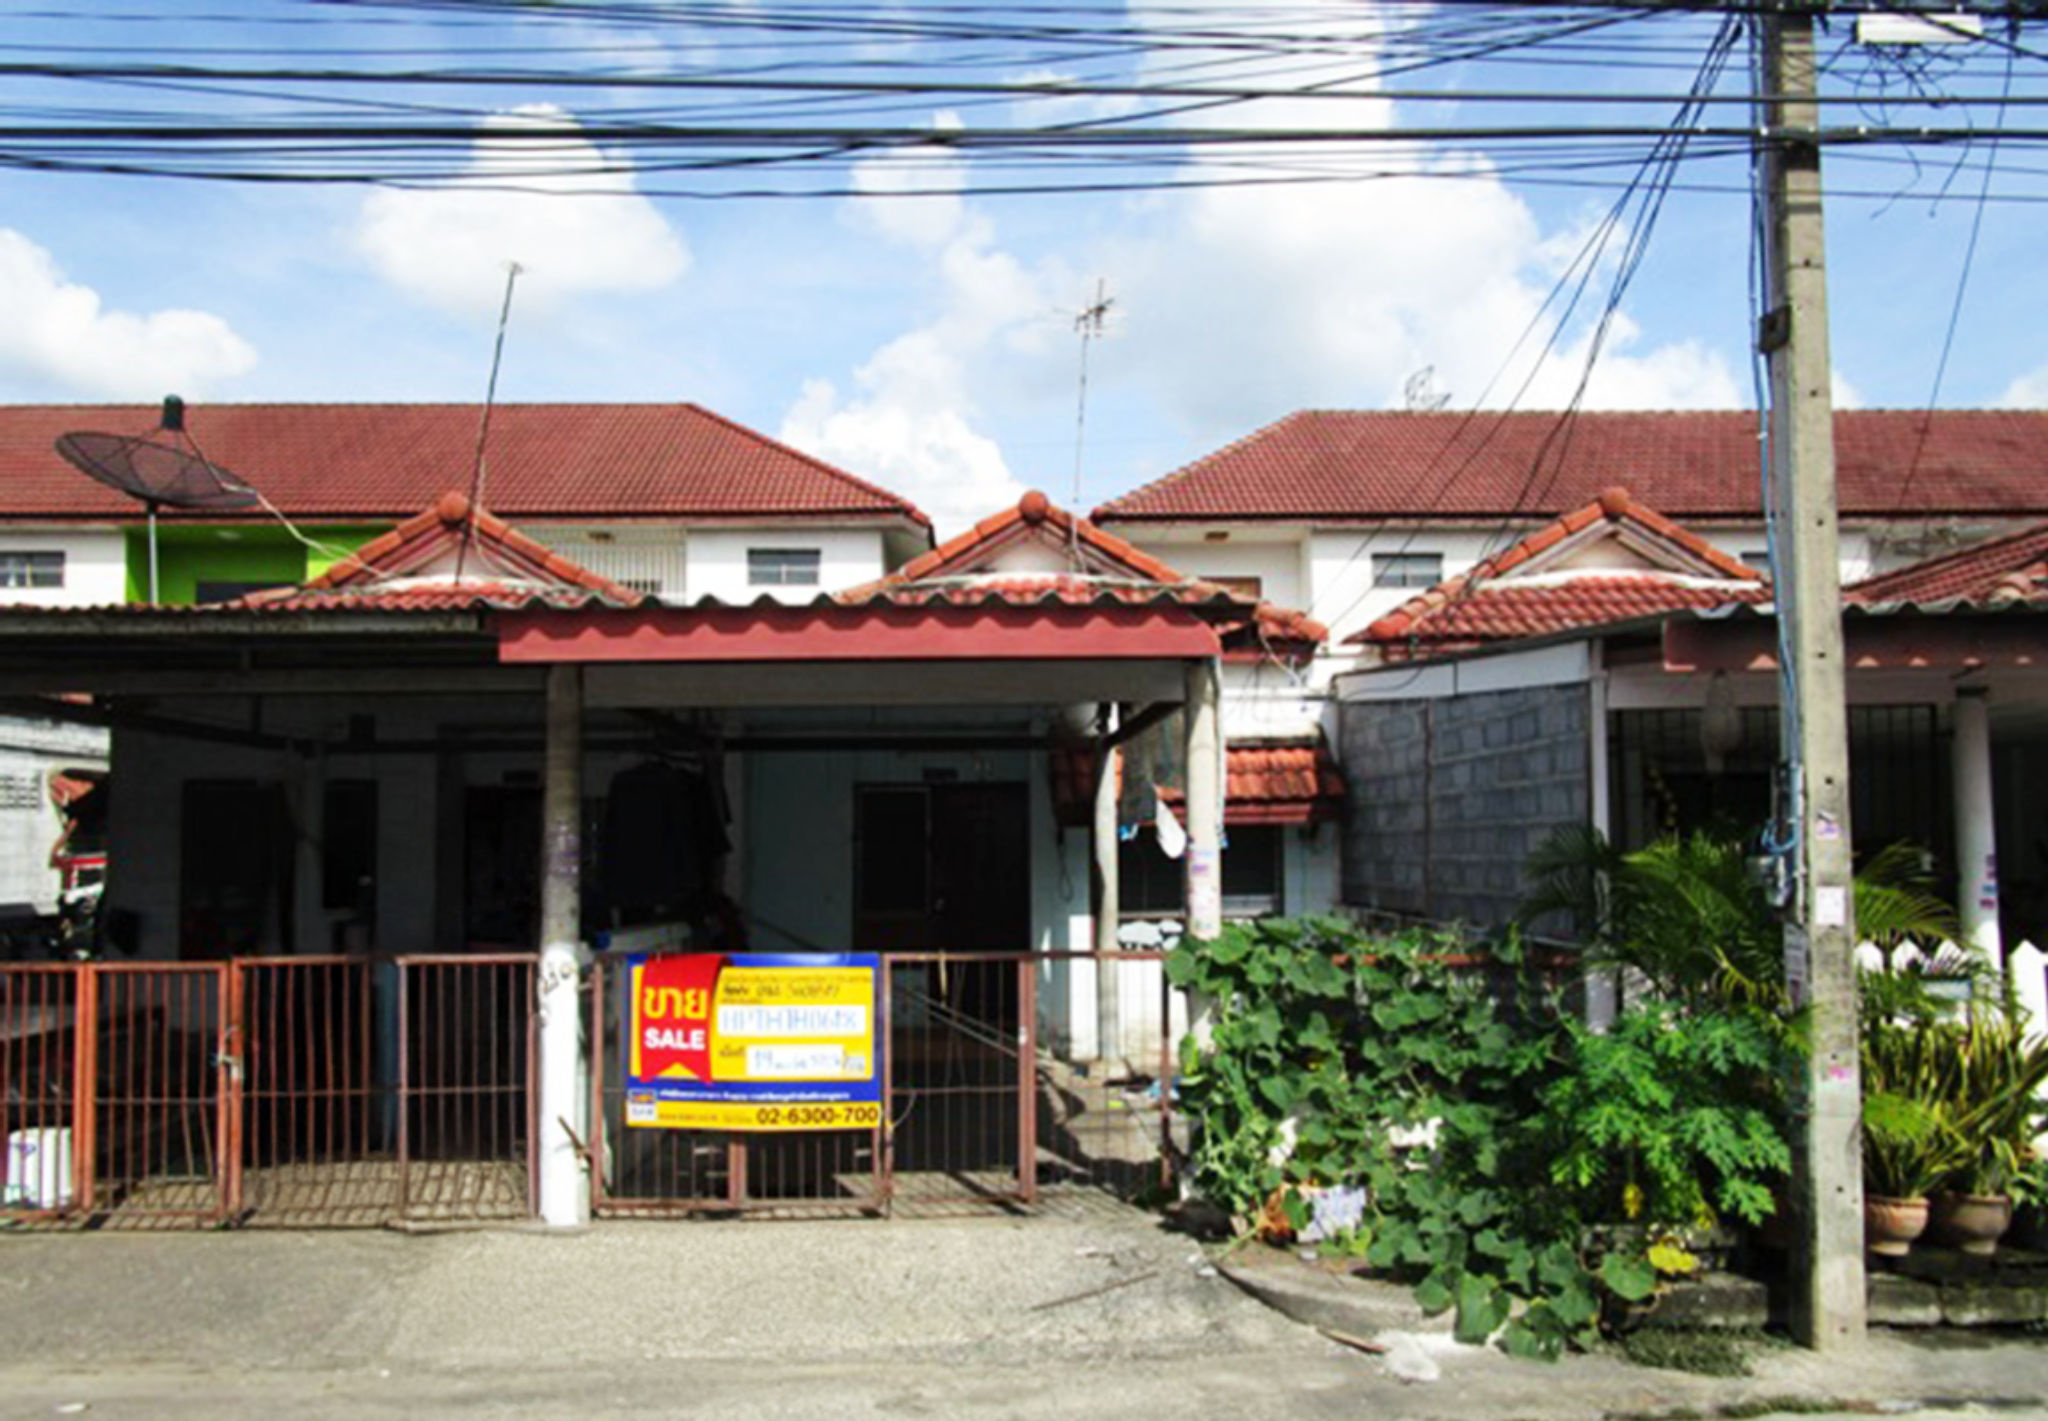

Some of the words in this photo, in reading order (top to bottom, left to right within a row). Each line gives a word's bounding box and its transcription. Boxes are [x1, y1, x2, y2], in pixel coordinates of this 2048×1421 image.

[645, 986, 707, 1019] ขาย
[645, 1028, 705, 1050] SALE
[756, 1107, 879, 1124] 02-6300-700
